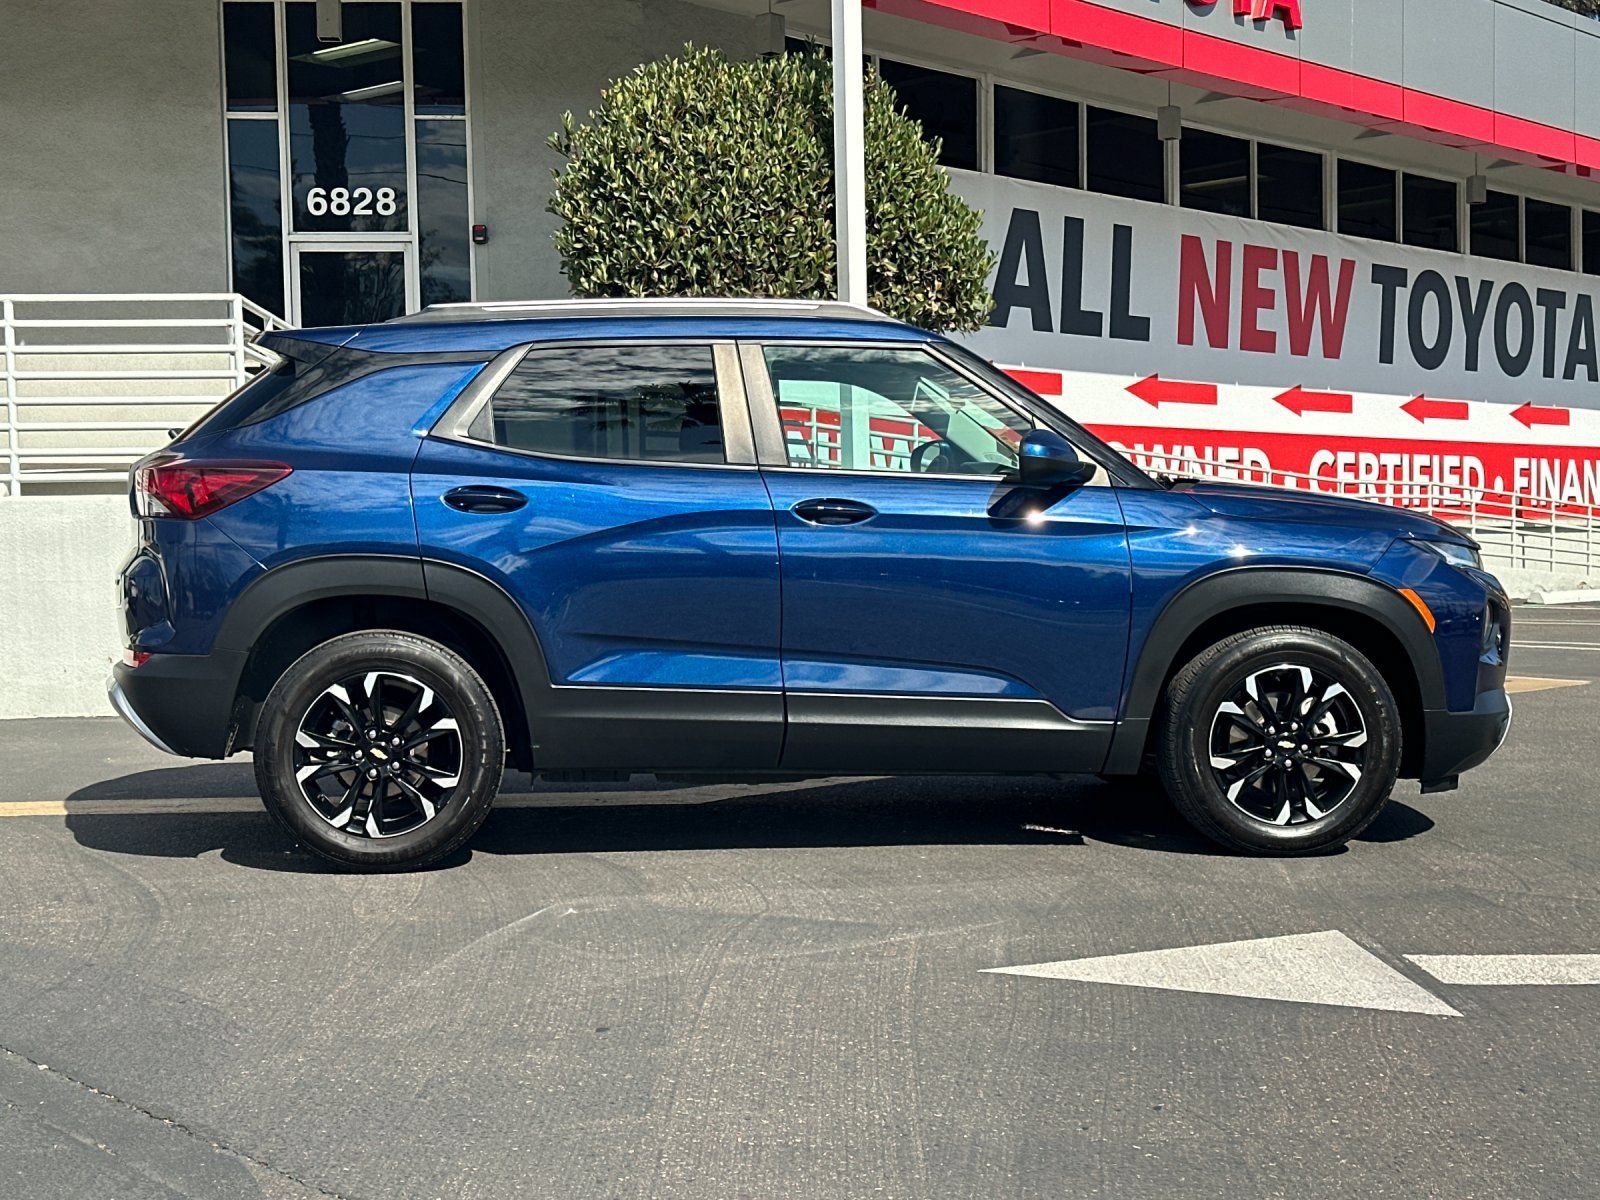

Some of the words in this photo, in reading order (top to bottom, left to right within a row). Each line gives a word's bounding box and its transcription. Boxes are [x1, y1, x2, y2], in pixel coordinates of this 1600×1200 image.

[306, 186, 397, 216] 6828
[986, 207, 1151, 342] ALL
[1177, 233, 1356, 360] NEW
[1371, 263, 1599, 382] TOYOTA
[1309, 449, 1485, 507] CERTIFIED
[1513, 457, 1600, 507] FINAN
